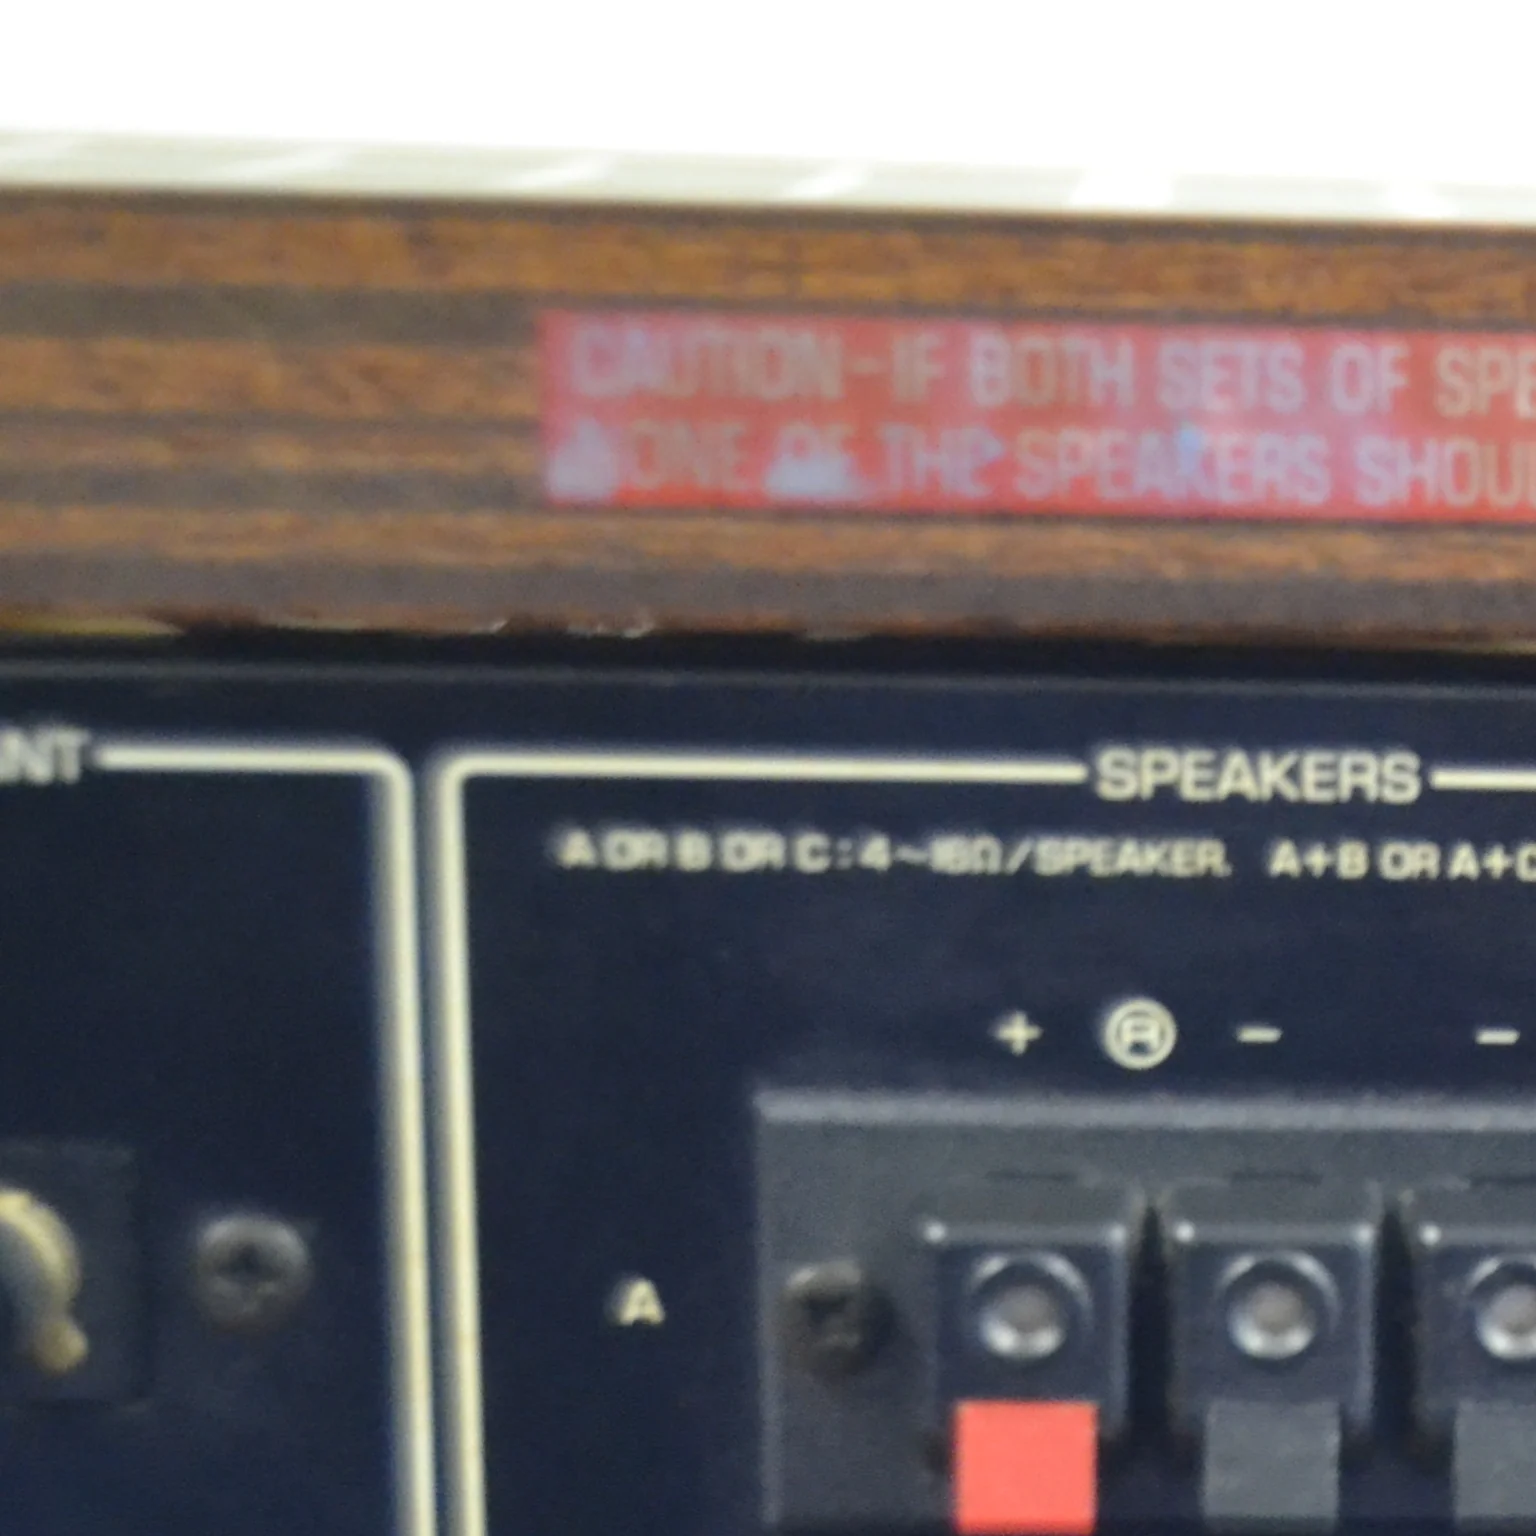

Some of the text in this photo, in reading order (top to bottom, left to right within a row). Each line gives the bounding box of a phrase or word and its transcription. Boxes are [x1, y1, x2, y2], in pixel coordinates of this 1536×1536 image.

[969, 331, 1134, 406] BOTH
[1157, 338, 1306, 413] SETS
[1329, 341, 1409, 414] OF
[1095, 747, 1421, 803] SPEAKERS
[619, 1280, 663, 1323] A
